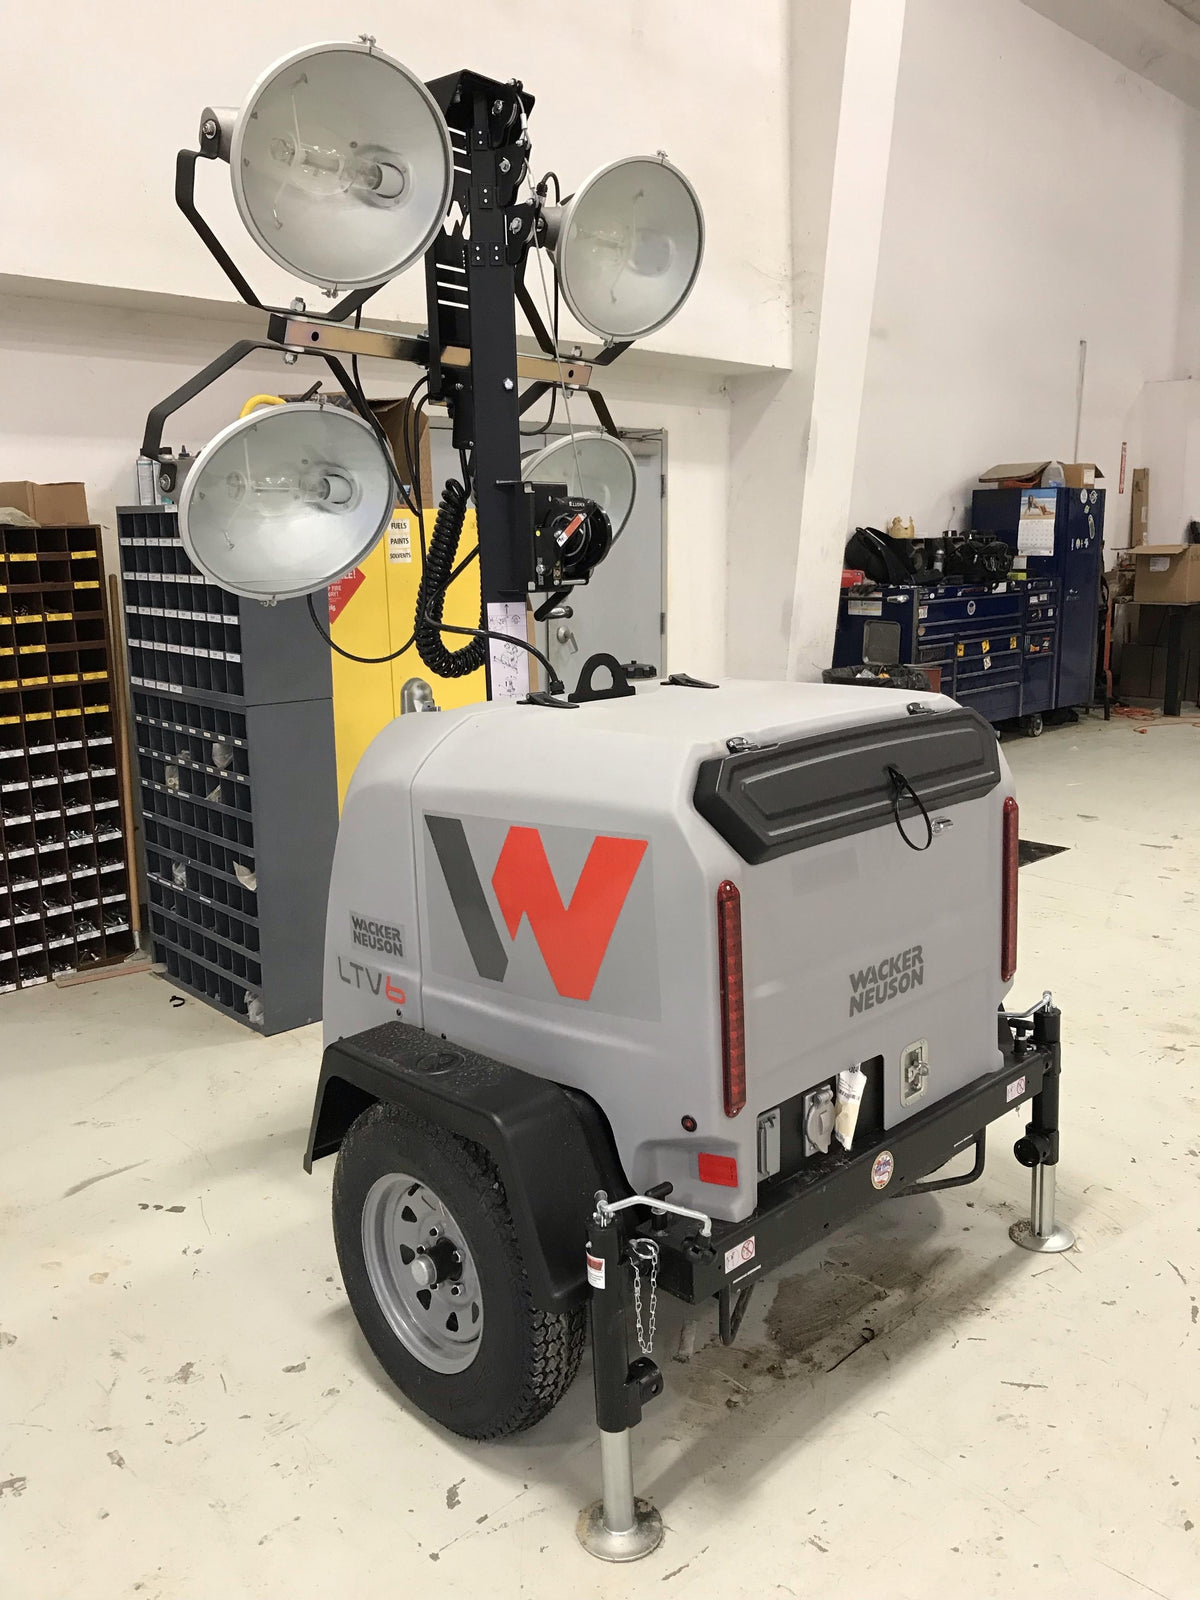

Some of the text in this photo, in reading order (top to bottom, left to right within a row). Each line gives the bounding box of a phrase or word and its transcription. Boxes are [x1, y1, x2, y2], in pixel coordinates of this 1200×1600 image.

[351, 915, 403, 943] WACKER
[352, 930, 404, 957] NEUSON
[337, 955, 406, 1006] LTV6
[848, 944, 924, 993] WACKER
[848, 965, 924, 1018] NEUSON
